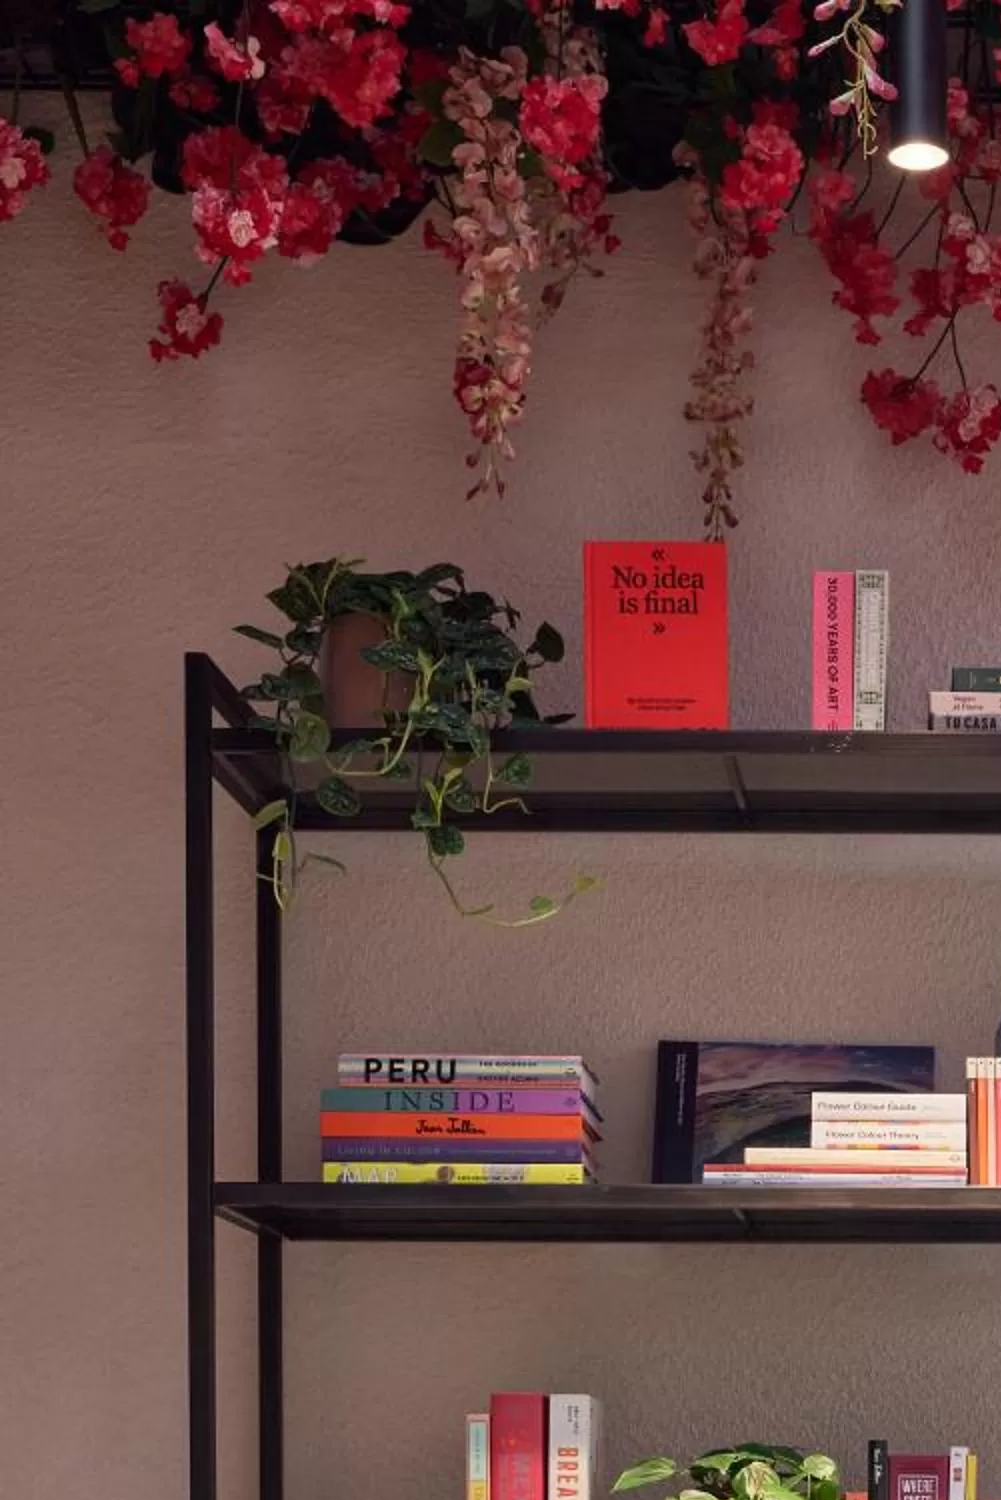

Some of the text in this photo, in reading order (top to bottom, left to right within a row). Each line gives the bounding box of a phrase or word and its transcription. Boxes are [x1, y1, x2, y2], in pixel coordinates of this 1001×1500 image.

[611, 565, 705, 591] No idea
[618, 590, 699, 615] is final
[827, 665, 839, 683] OF
[827, 686, 839, 711] ART
[963, 716, 997, 730] CASA
[364, 1058, 456, 1084] PERU
[384, 1091, 515, 1112] INSIDE
[901, 1479, 936, 1493] WHERE
